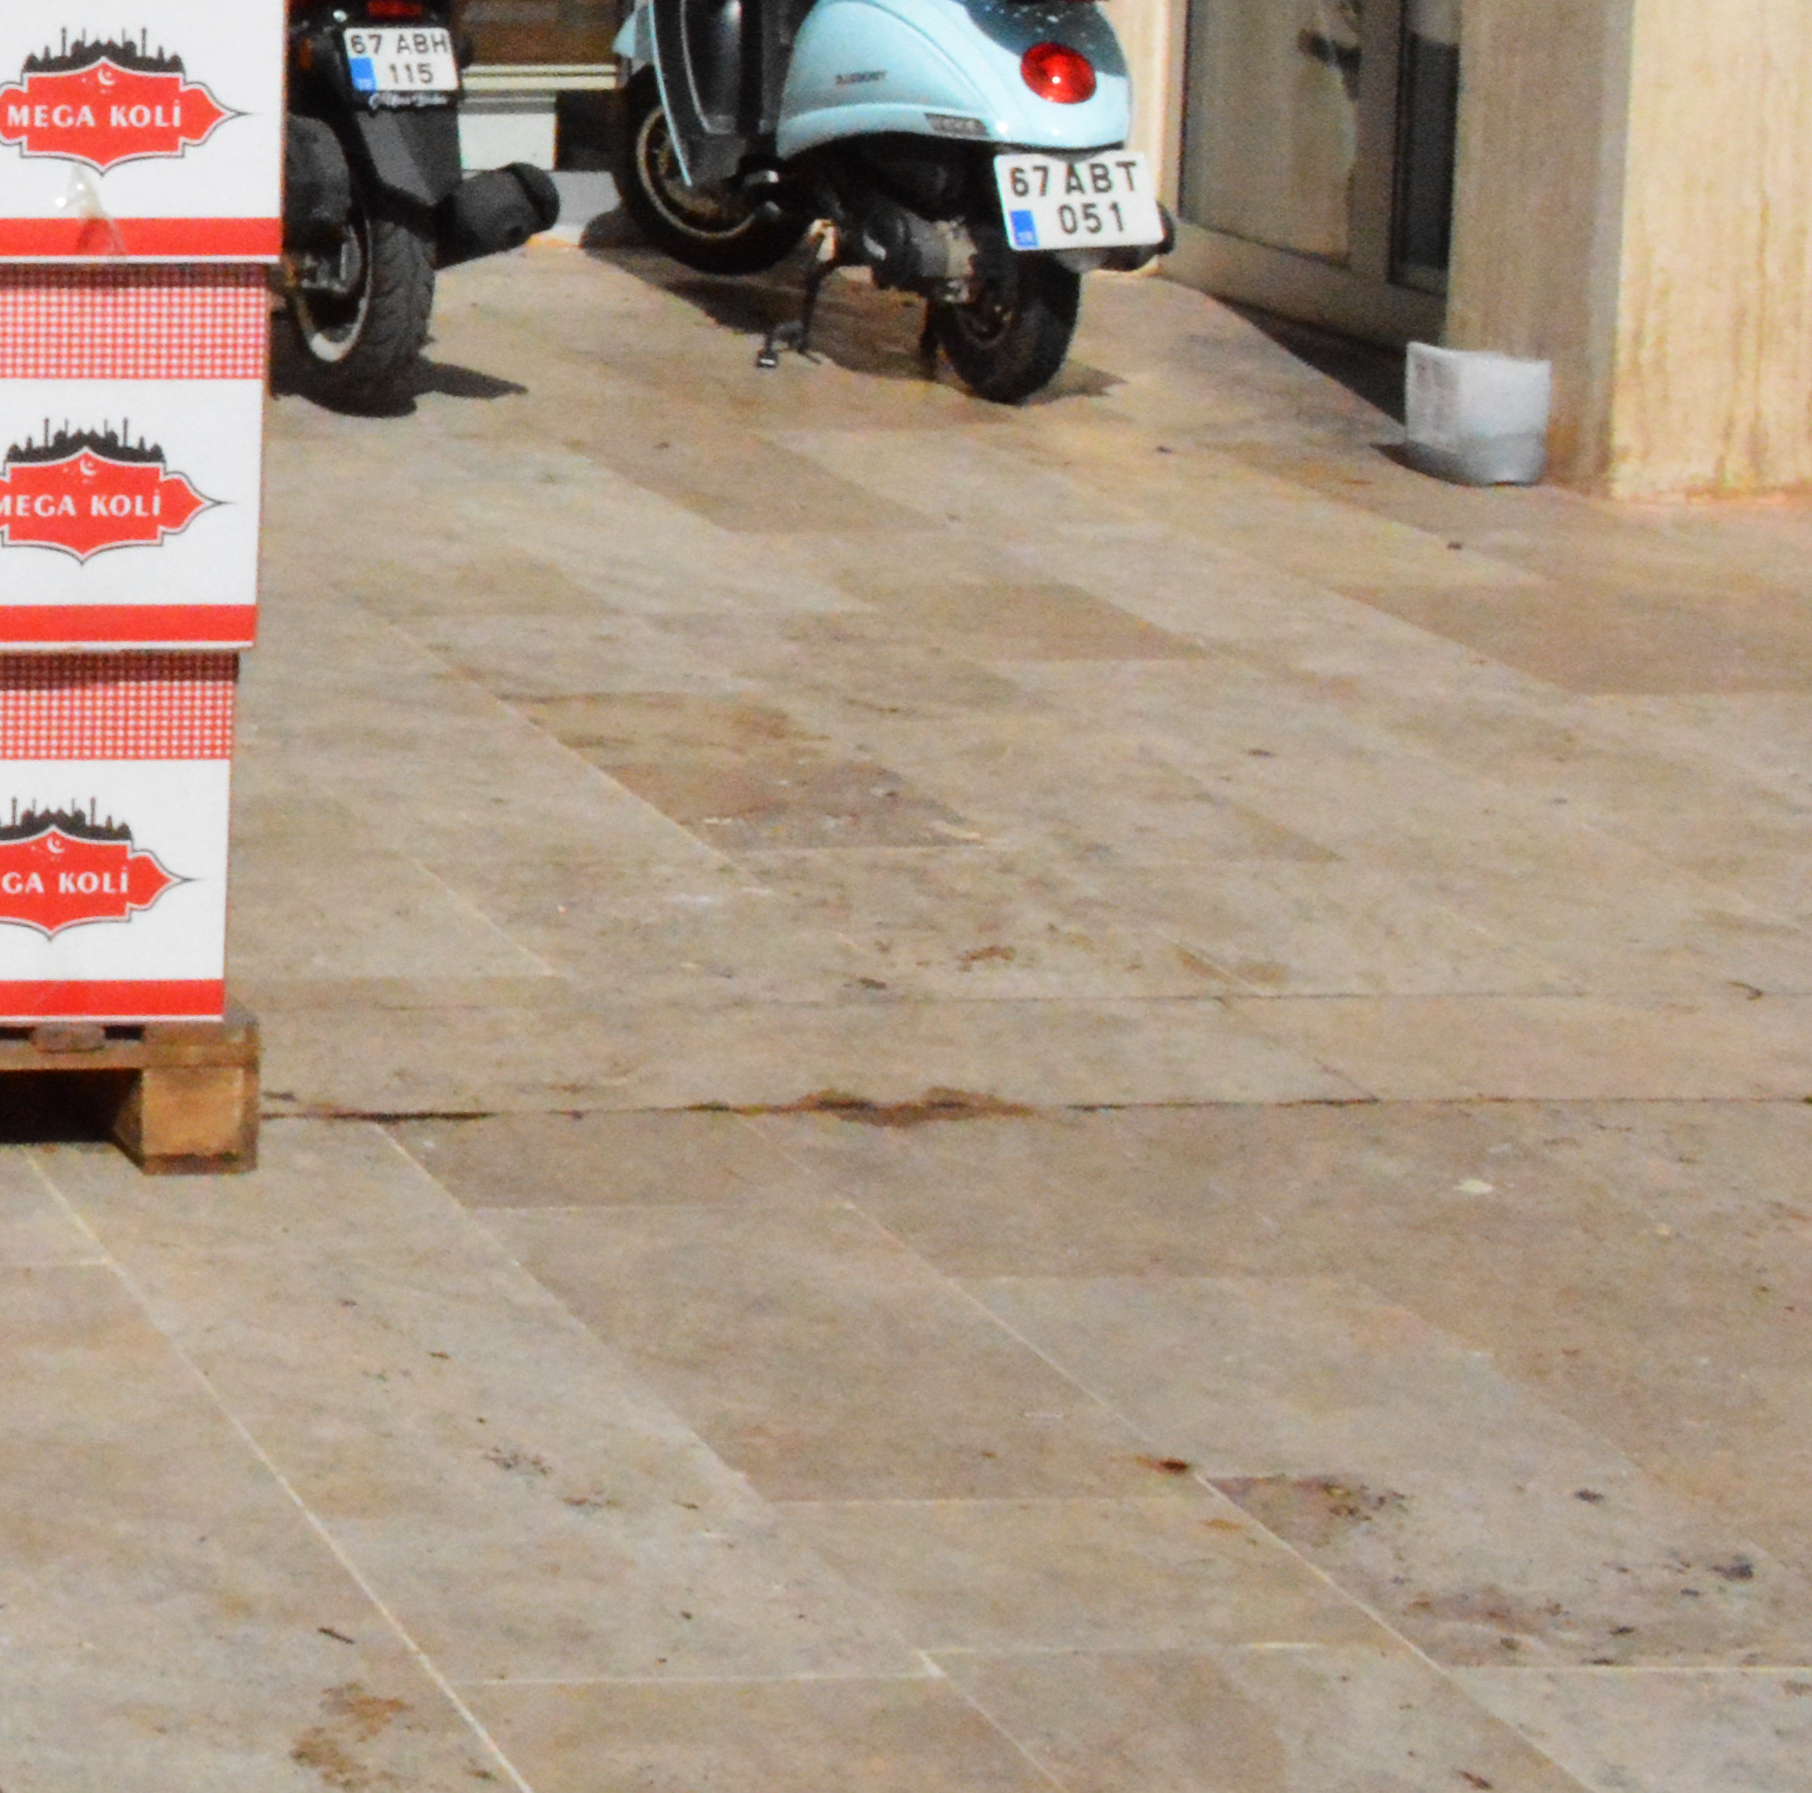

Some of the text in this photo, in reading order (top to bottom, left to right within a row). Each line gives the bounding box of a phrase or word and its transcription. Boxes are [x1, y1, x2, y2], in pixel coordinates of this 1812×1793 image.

[350, 33, 447, 55] 67 ABH
[388, 63, 433, 84] 115
[7, 99, 182, 128] MEGA KOLİ
[1010, 161, 1137, 197] 67 ABT
[1058, 201, 1124, 234] 051
[90, 489, 162, 517] KOLİ
[58, 866, 129, 894] KOLİ
